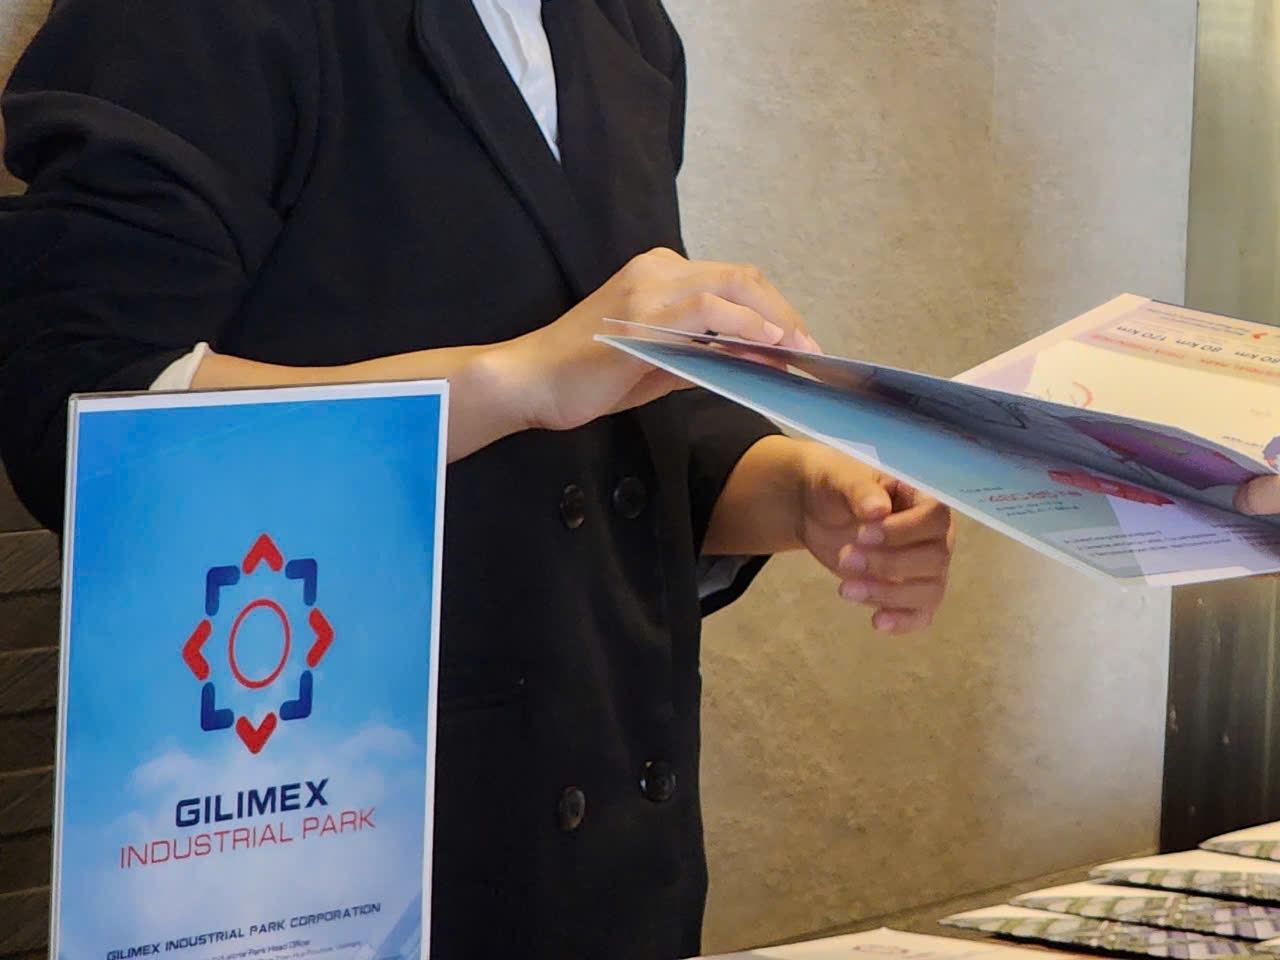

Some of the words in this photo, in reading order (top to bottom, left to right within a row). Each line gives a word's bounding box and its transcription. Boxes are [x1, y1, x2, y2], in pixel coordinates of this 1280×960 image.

[1116, 325, 1140, 336] km
[1175, 338, 1199, 348] km
[1234, 350, 1259, 361] km
[175, 779, 329, 827] GILIMEX
[121, 823, 292, 868] INDUSTRIAL
[302, 808, 376, 839] PARK
[106, 942, 160, 960] GILIMEX
[165, 927, 245, 951] INDUSTRIAL
[249, 919, 286, 936] PARK
[290, 903, 381, 928] CORPORATION
